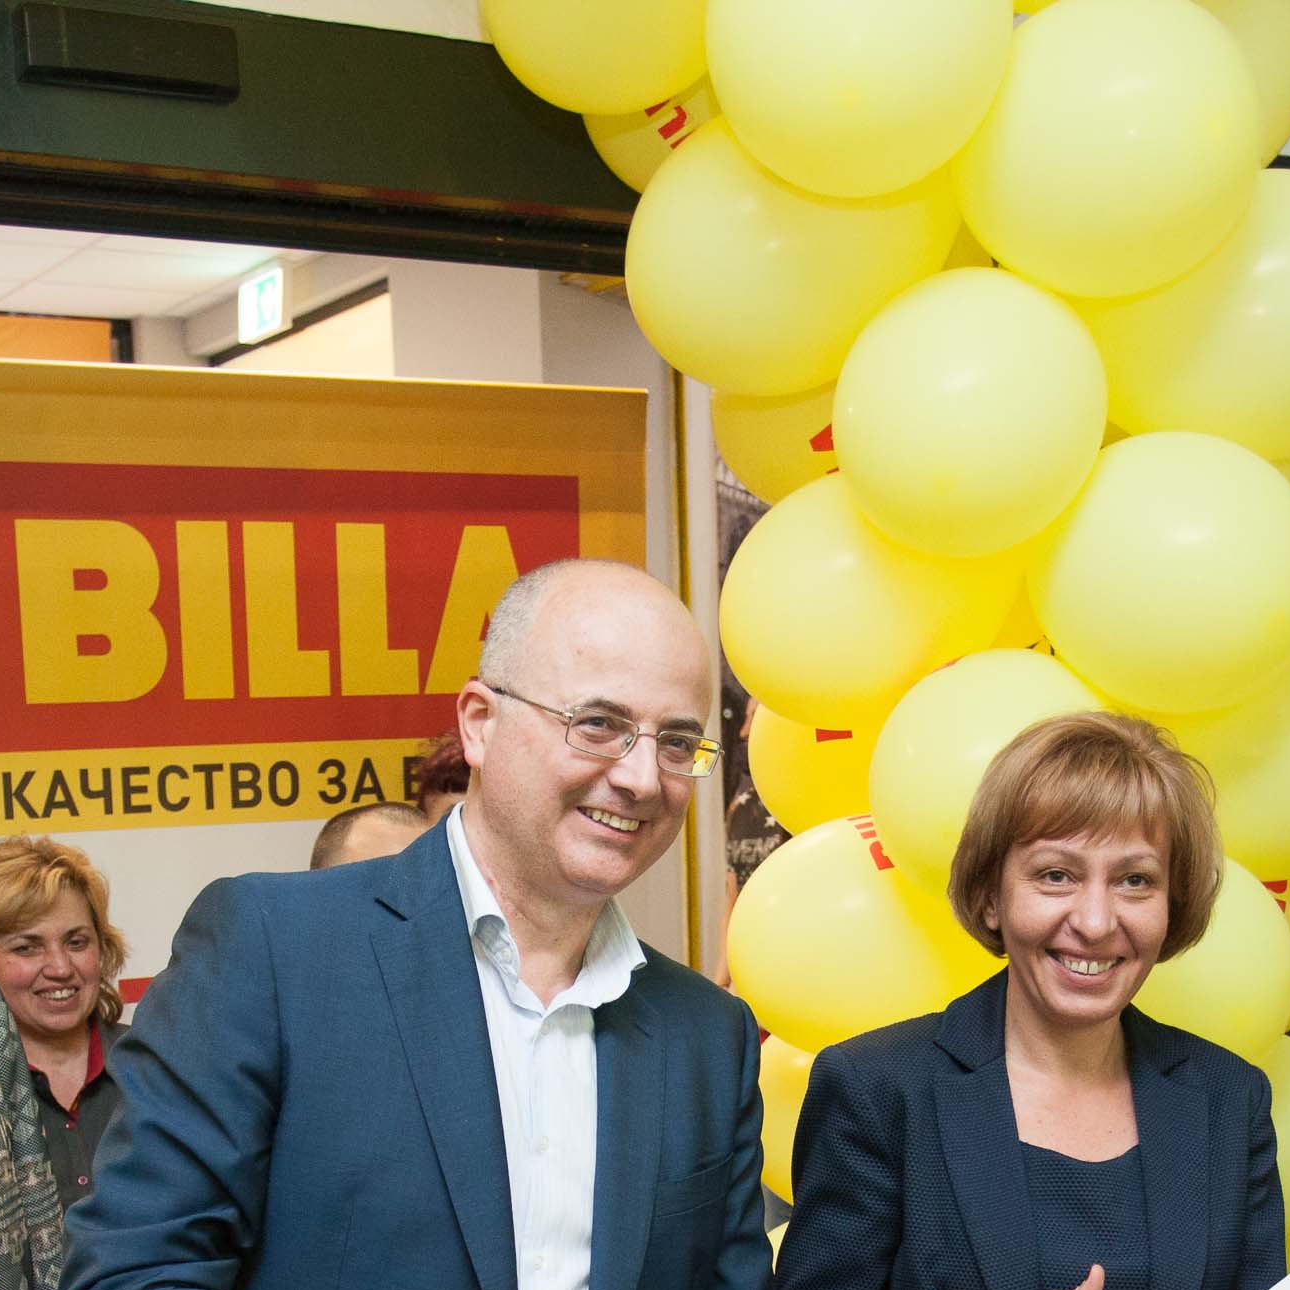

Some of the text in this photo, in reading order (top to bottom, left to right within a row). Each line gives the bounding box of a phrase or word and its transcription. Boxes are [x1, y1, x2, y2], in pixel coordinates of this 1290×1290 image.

[14, 518, 519, 705] BILLA
[1, 760, 300, 821] КАЧЕСТВО
[317, 756, 386, 804] ЗА
